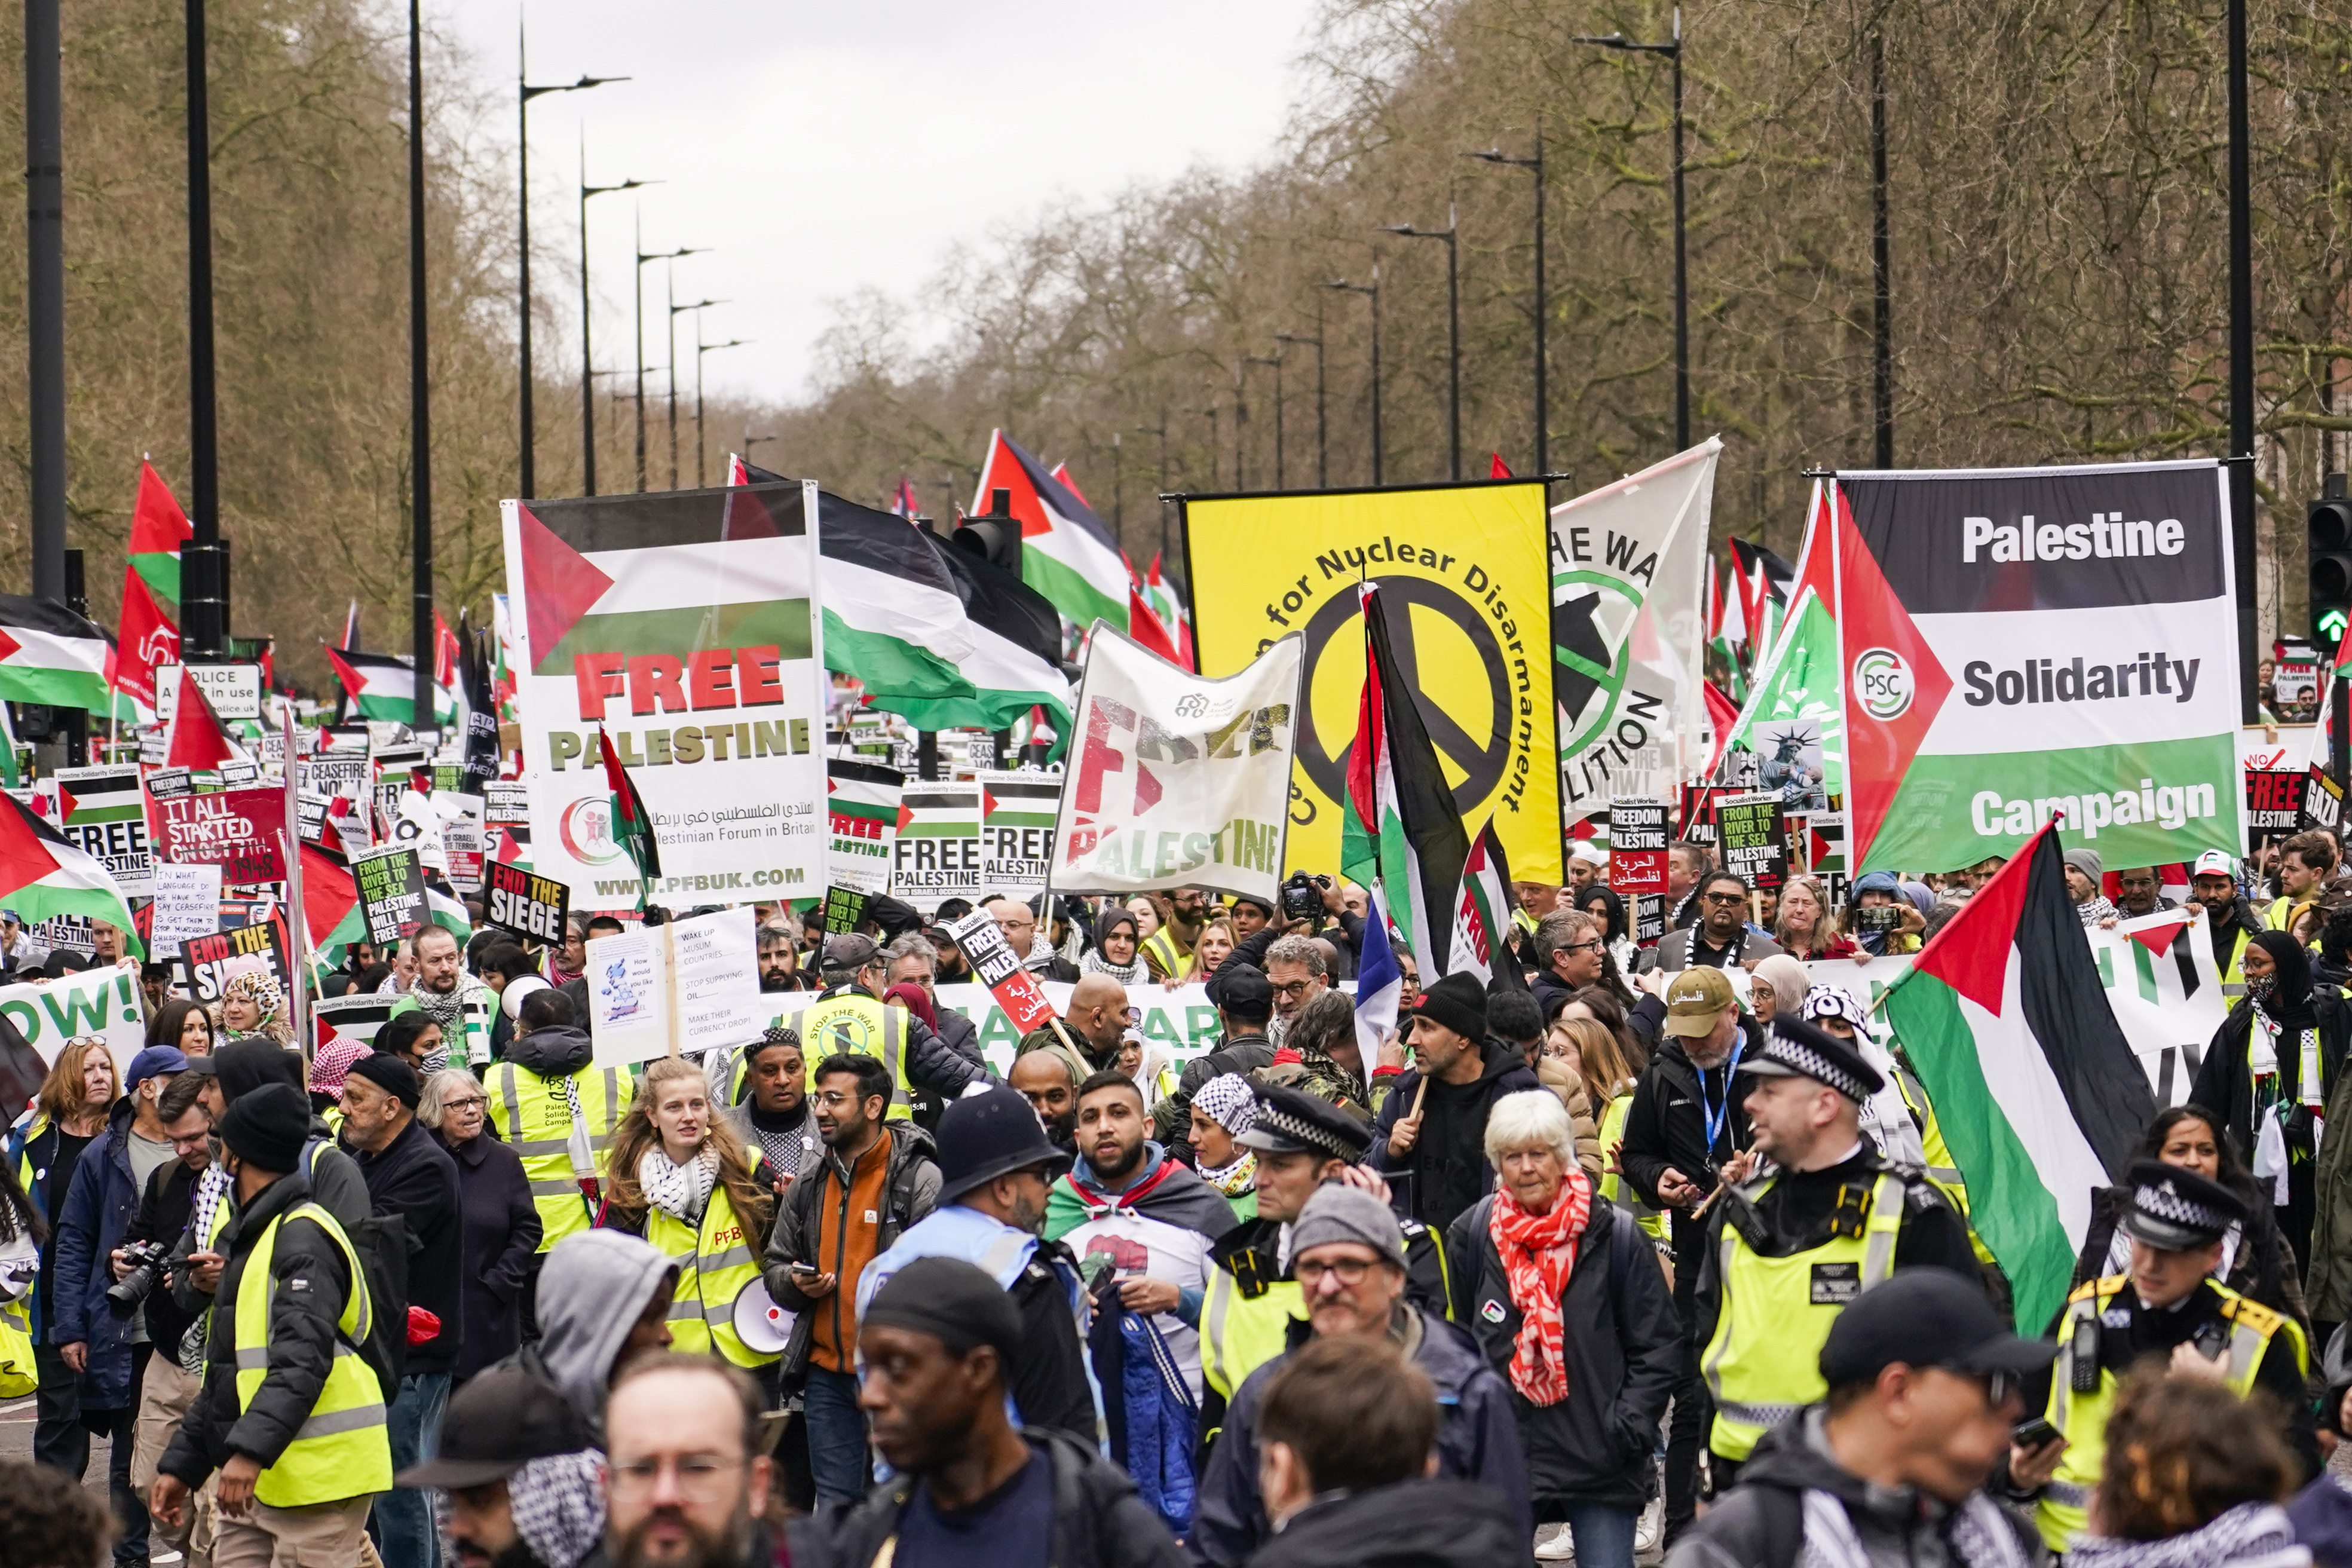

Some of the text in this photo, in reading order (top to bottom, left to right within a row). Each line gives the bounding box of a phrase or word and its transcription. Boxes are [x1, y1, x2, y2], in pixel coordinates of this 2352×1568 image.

[1963, 512, 2185, 564] Palestine
[191, 671, 236, 682] OLICE
[1266, 535, 1535, 814] for Nuclear Disarmament
[2282, 663, 2311, 674] FREE
[573, 643, 784, 722] FREE
[1864, 674, 1901, 696] PSC
[1964, 651, 2201, 708] Solidarity
[212, 688, 224, 698] in
[229, 690, 253, 698] use
[549, 717, 810, 771] PALESTINE
[1563, 690, 1663, 803] LITION
[2249, 754, 2268, 765] NO
[109, 767, 136, 776] Campaign
[224, 766, 255, 782] FREEDOM
[311, 762, 366, 780] CEASEFIRE
[436, 766, 457, 776] FROM
[150, 776, 188, 792] FREEDOM
[436, 776, 457, 786] RIVER
[488, 791, 528, 804] FREEDOM
[1725, 795, 1772, 806] Socialist Worker
[2305, 779, 2340, 828] GAZA
[163, 796, 235, 824] IT ALL
[486, 808, 530, 821] PALESTINE
[1612, 808, 1662, 825] FREEDOM
[1723, 807, 1753, 822] FROM
[1756, 804, 1775, 817] THE
[1971, 778, 2216, 839] Campaign
[167, 817, 253, 843] STARTED
[657, 821, 815, 845] lestinian Forum in Britain
[1630, 825, 1640, 833] for
[1725, 820, 1754, 835] RIVER
[1757, 818, 1771, 832] TO
[63, 821, 148, 856] FREE
[455, 843, 477, 851] TERROR
[1610, 832, 1666, 849] PALESTINE
[1725, 832, 1768, 849] THE SEA
[358, 844, 406, 860] Socialist Worker
[895, 839, 979, 870] FREE
[1066, 817, 1278, 878] PALESTINE
[1726, 844, 1781, 862] PALESTINE
[358, 852, 411, 877] FROM THE
[1615, 855, 1655, 871] الحرية
[1728, 859, 1770, 875] WILL BE
[158, 871, 197, 880] IN WHAT
[360, 868, 408, 890] RIVER TO
[895, 871, 979, 886] PALESTINE
[1613, 871, 1661, 886] لفلسطين
[157, 882, 195, 890] LANGUAGE
[363, 881, 407, 904] THE SEA
[493, 864, 526, 895] END
[531, 875, 562, 908] THE
[174, 903, 215, 911] CEASEFIRE
[366, 892, 422, 917] PALESTINE
[830, 889, 864, 910] FROM THE
[155, 915, 163, 924] TO
[370, 908, 412, 931] WILL BE
[490, 887, 560, 942] SIEGE
[828, 902, 858, 923] RIVER TO
[826, 917, 839, 933] THE
[958, 914, 983, 933] Socialist
[373, 925, 399, 945] FREE
[681, 928, 715, 941] WAKE UP
[154, 944, 174, 953] THEIR
[187, 924, 272, 965] END THE
[683, 941, 711, 954] MUSLIM
[632, 968, 651, 976] would
[685, 970, 744, 990] STOP SUPPLYING
[316, 998, 374, 1012] Palestine Solidarity
[1671, 990, 1704, 1005] فلسطين
[688, 1009, 731, 1024] MAKE THEIR
[810, 1009, 876, 1040] STOP THE WAR
[689, 1016, 752, 1036] CURRENCY DROP!
